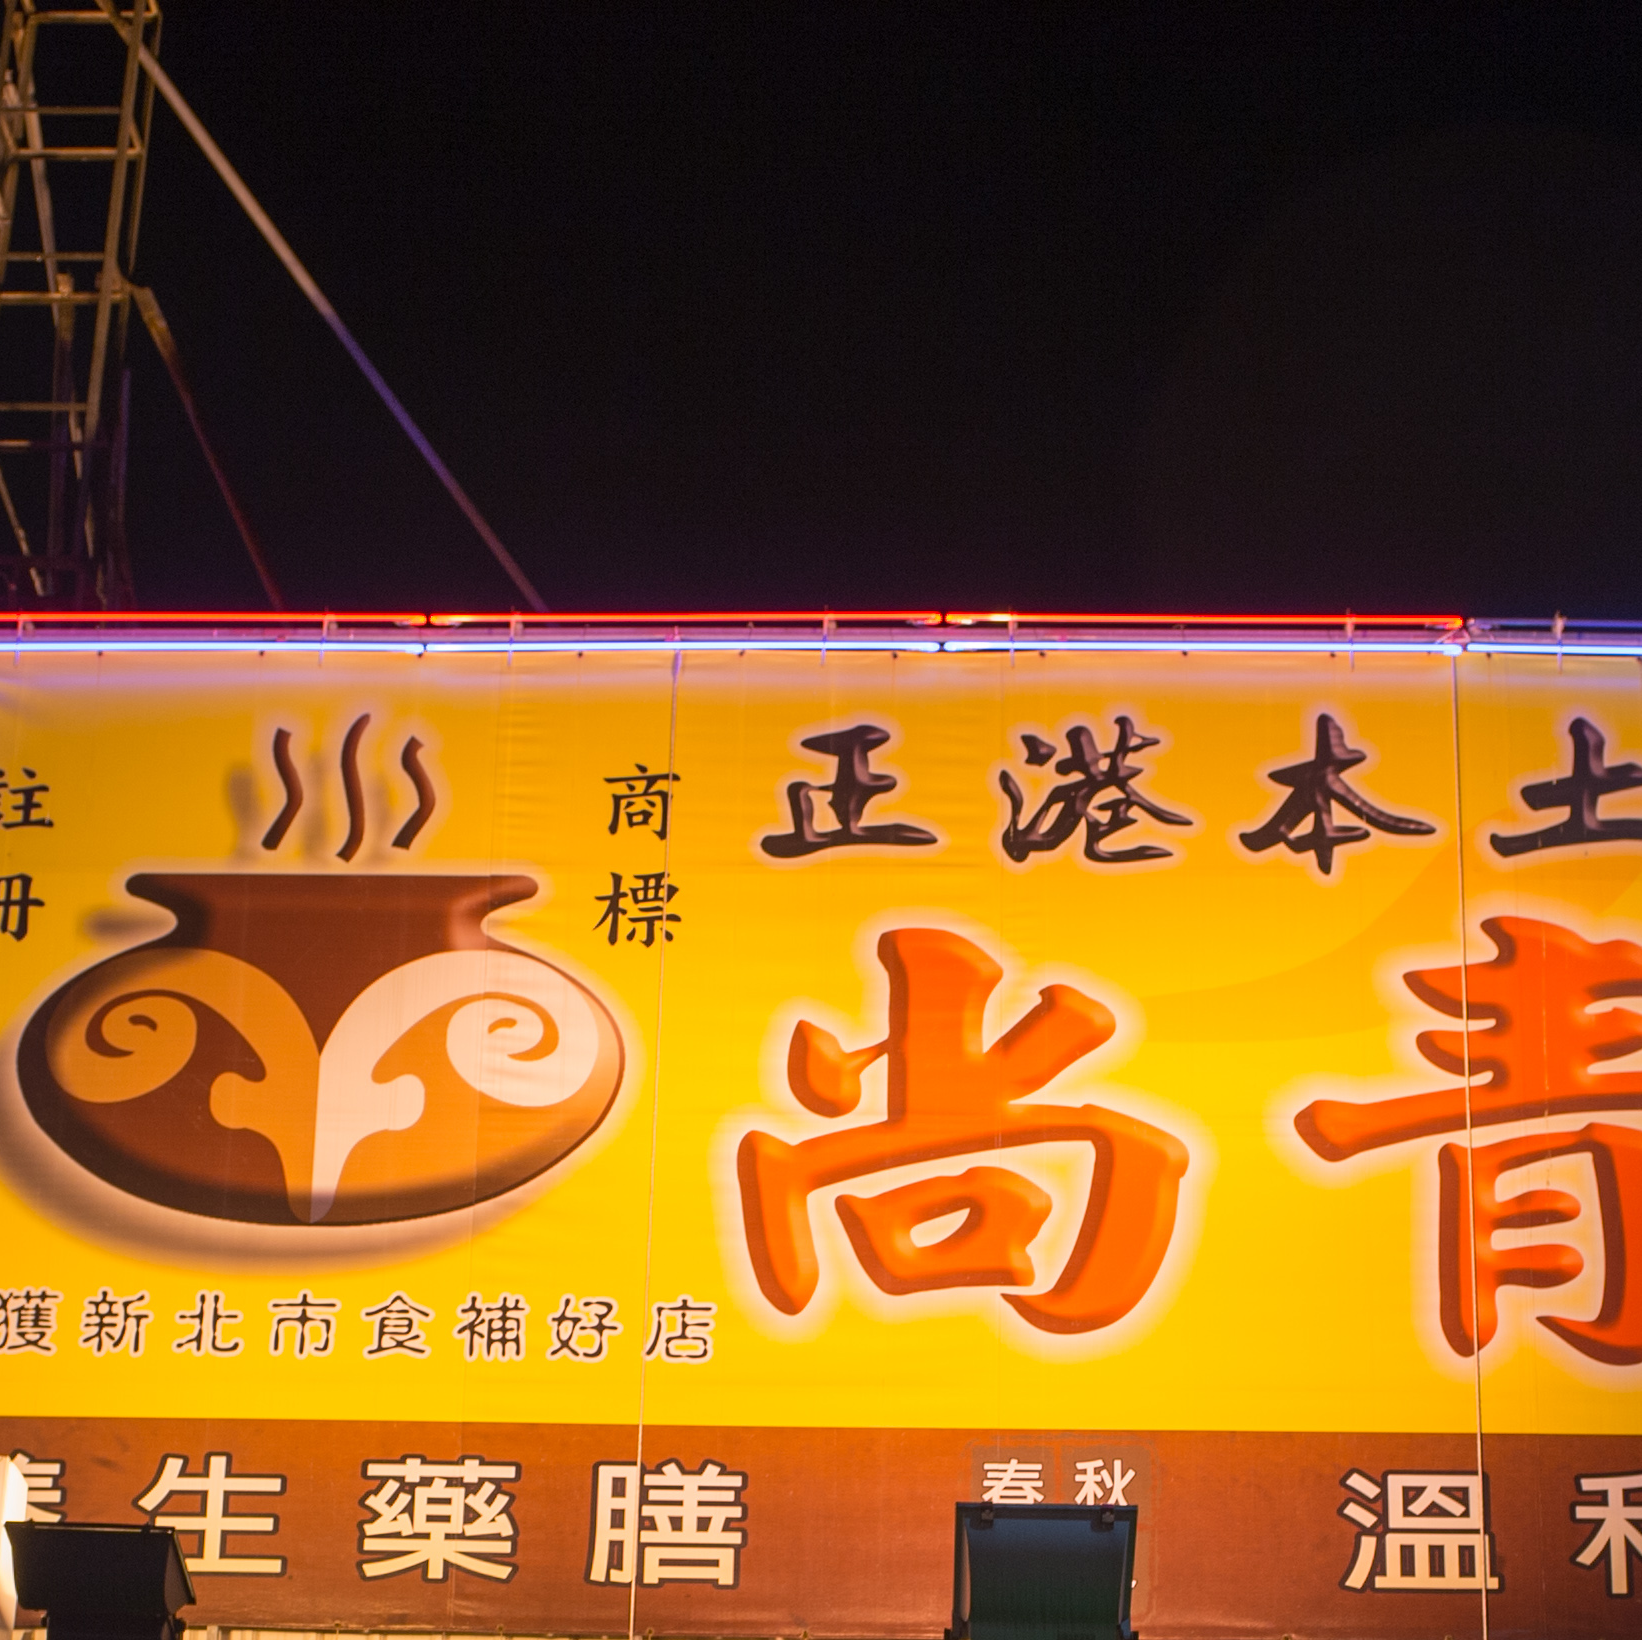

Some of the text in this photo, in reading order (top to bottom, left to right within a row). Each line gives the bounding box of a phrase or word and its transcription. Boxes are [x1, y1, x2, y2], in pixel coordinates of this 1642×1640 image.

[592, 763, 682, 950] 商標
[26, 1453, 748, 1588] 生藥膳
